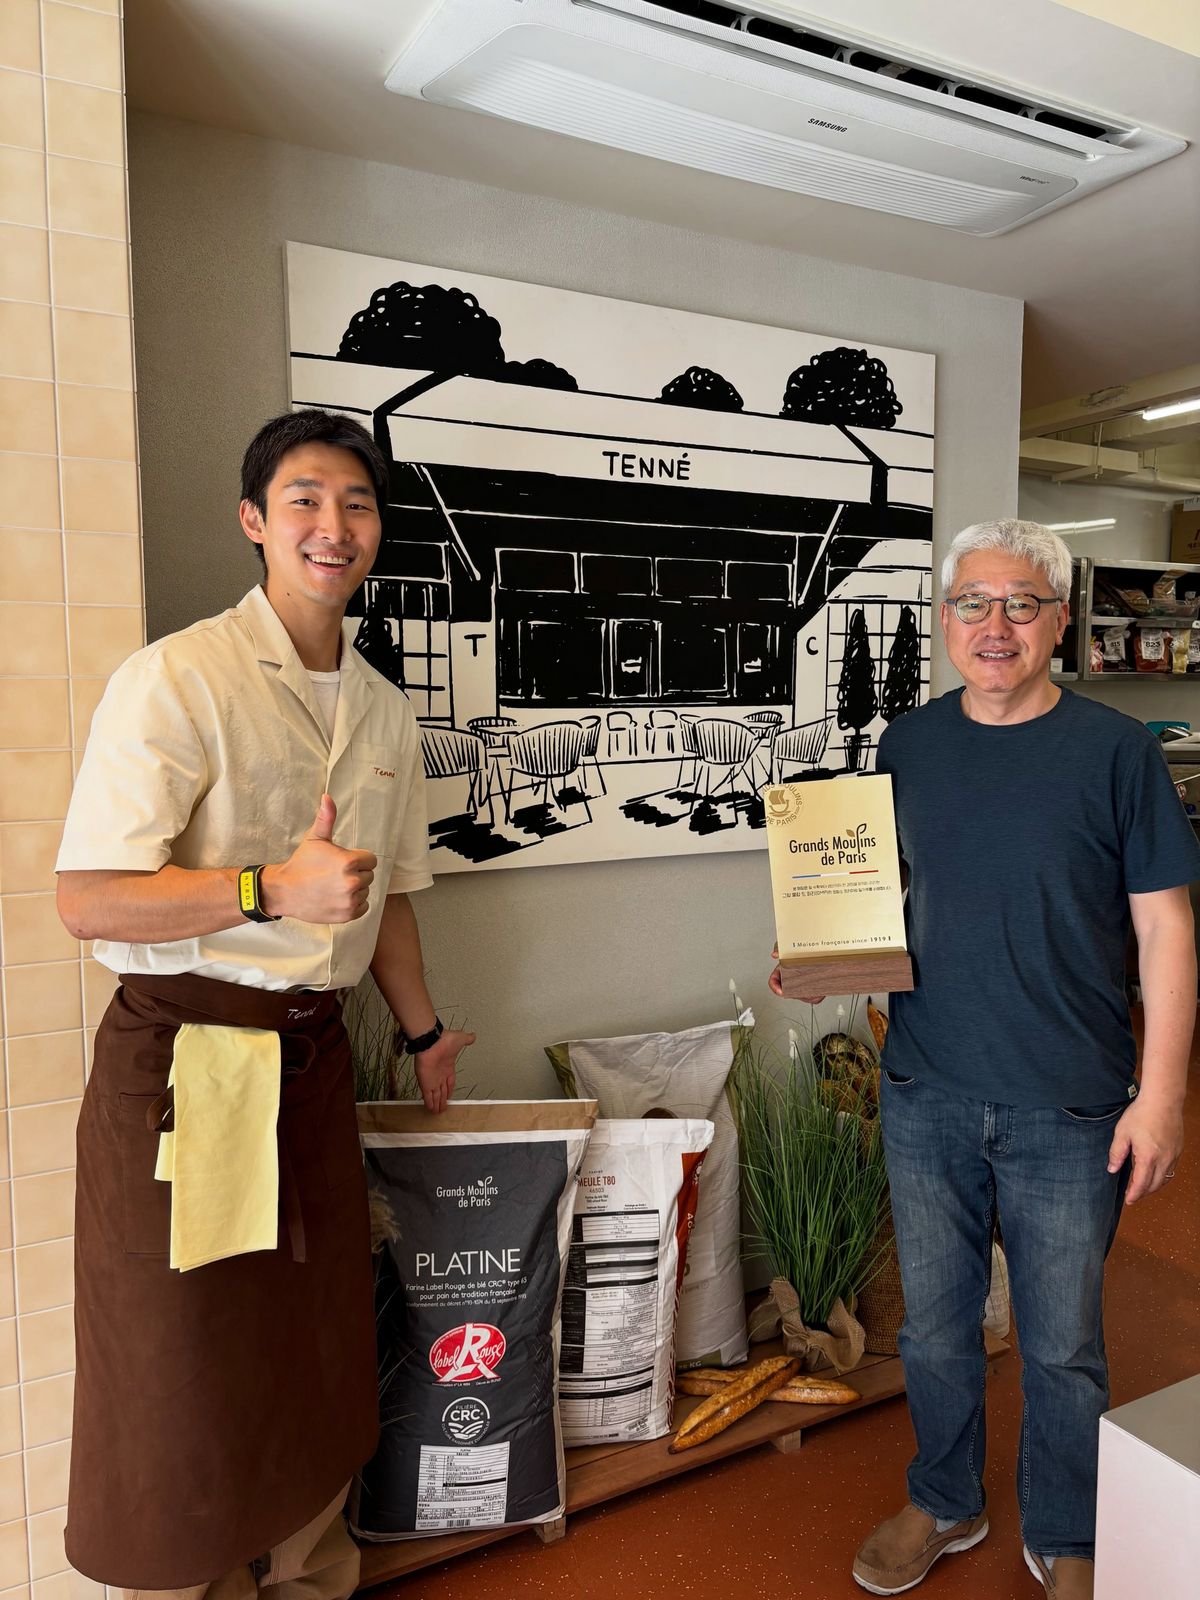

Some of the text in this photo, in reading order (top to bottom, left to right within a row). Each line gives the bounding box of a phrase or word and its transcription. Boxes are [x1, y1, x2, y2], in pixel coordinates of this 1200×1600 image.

[808, 118, 848, 133] SAMSUNG
[602, 451, 691, 480] TENNÉ
[464, 633, 487, 657] T
[805, 636, 819, 656] C
[776, 813, 797, 826] PARIS
[789, 823, 876, 854] Grands Moulins
[821, 850, 867, 866] de Paris
[821, 939, 850, 947] française
[870, 935, 887, 943] 1919
[436, 1175, 499, 1199] Grands Moulins
[578, 1175, 616, 1188] MEULE T80
[458, 1196, 491, 1208] de Paris
[416, 1248, 521, 1277] PLATINE
[405, 1283, 425, 1291] Farine
[426, 1281, 443, 1291] Label
[444, 1280, 466, 1291] Rouge
[467, 1279, 476, 1289] de
[476, 1279, 486, 1288] blé
[507, 1279, 520, 1288] type
[420, 1287, 516, 1301] pour pain de tradition française
